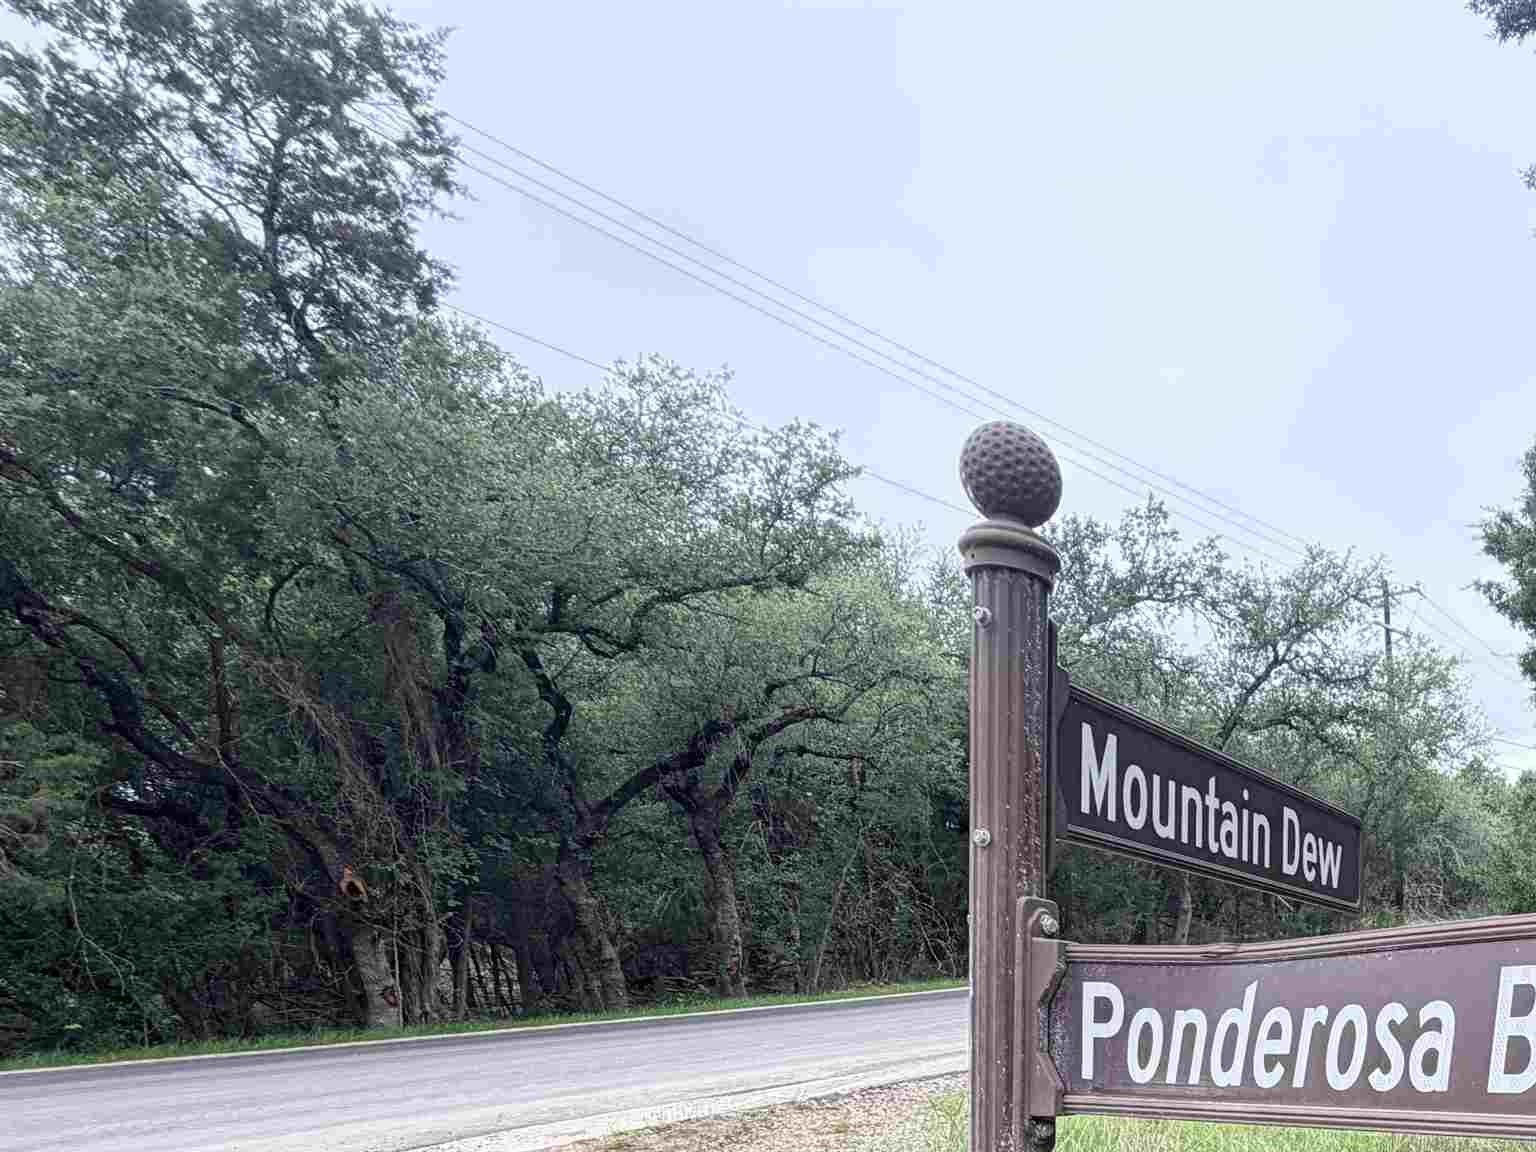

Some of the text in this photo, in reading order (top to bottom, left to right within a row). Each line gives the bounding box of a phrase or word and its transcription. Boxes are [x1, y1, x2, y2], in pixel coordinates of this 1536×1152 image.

[1080, 722, 1343, 888] Mountain Dew
[1081, 980, 1457, 1093] Ponderosa
